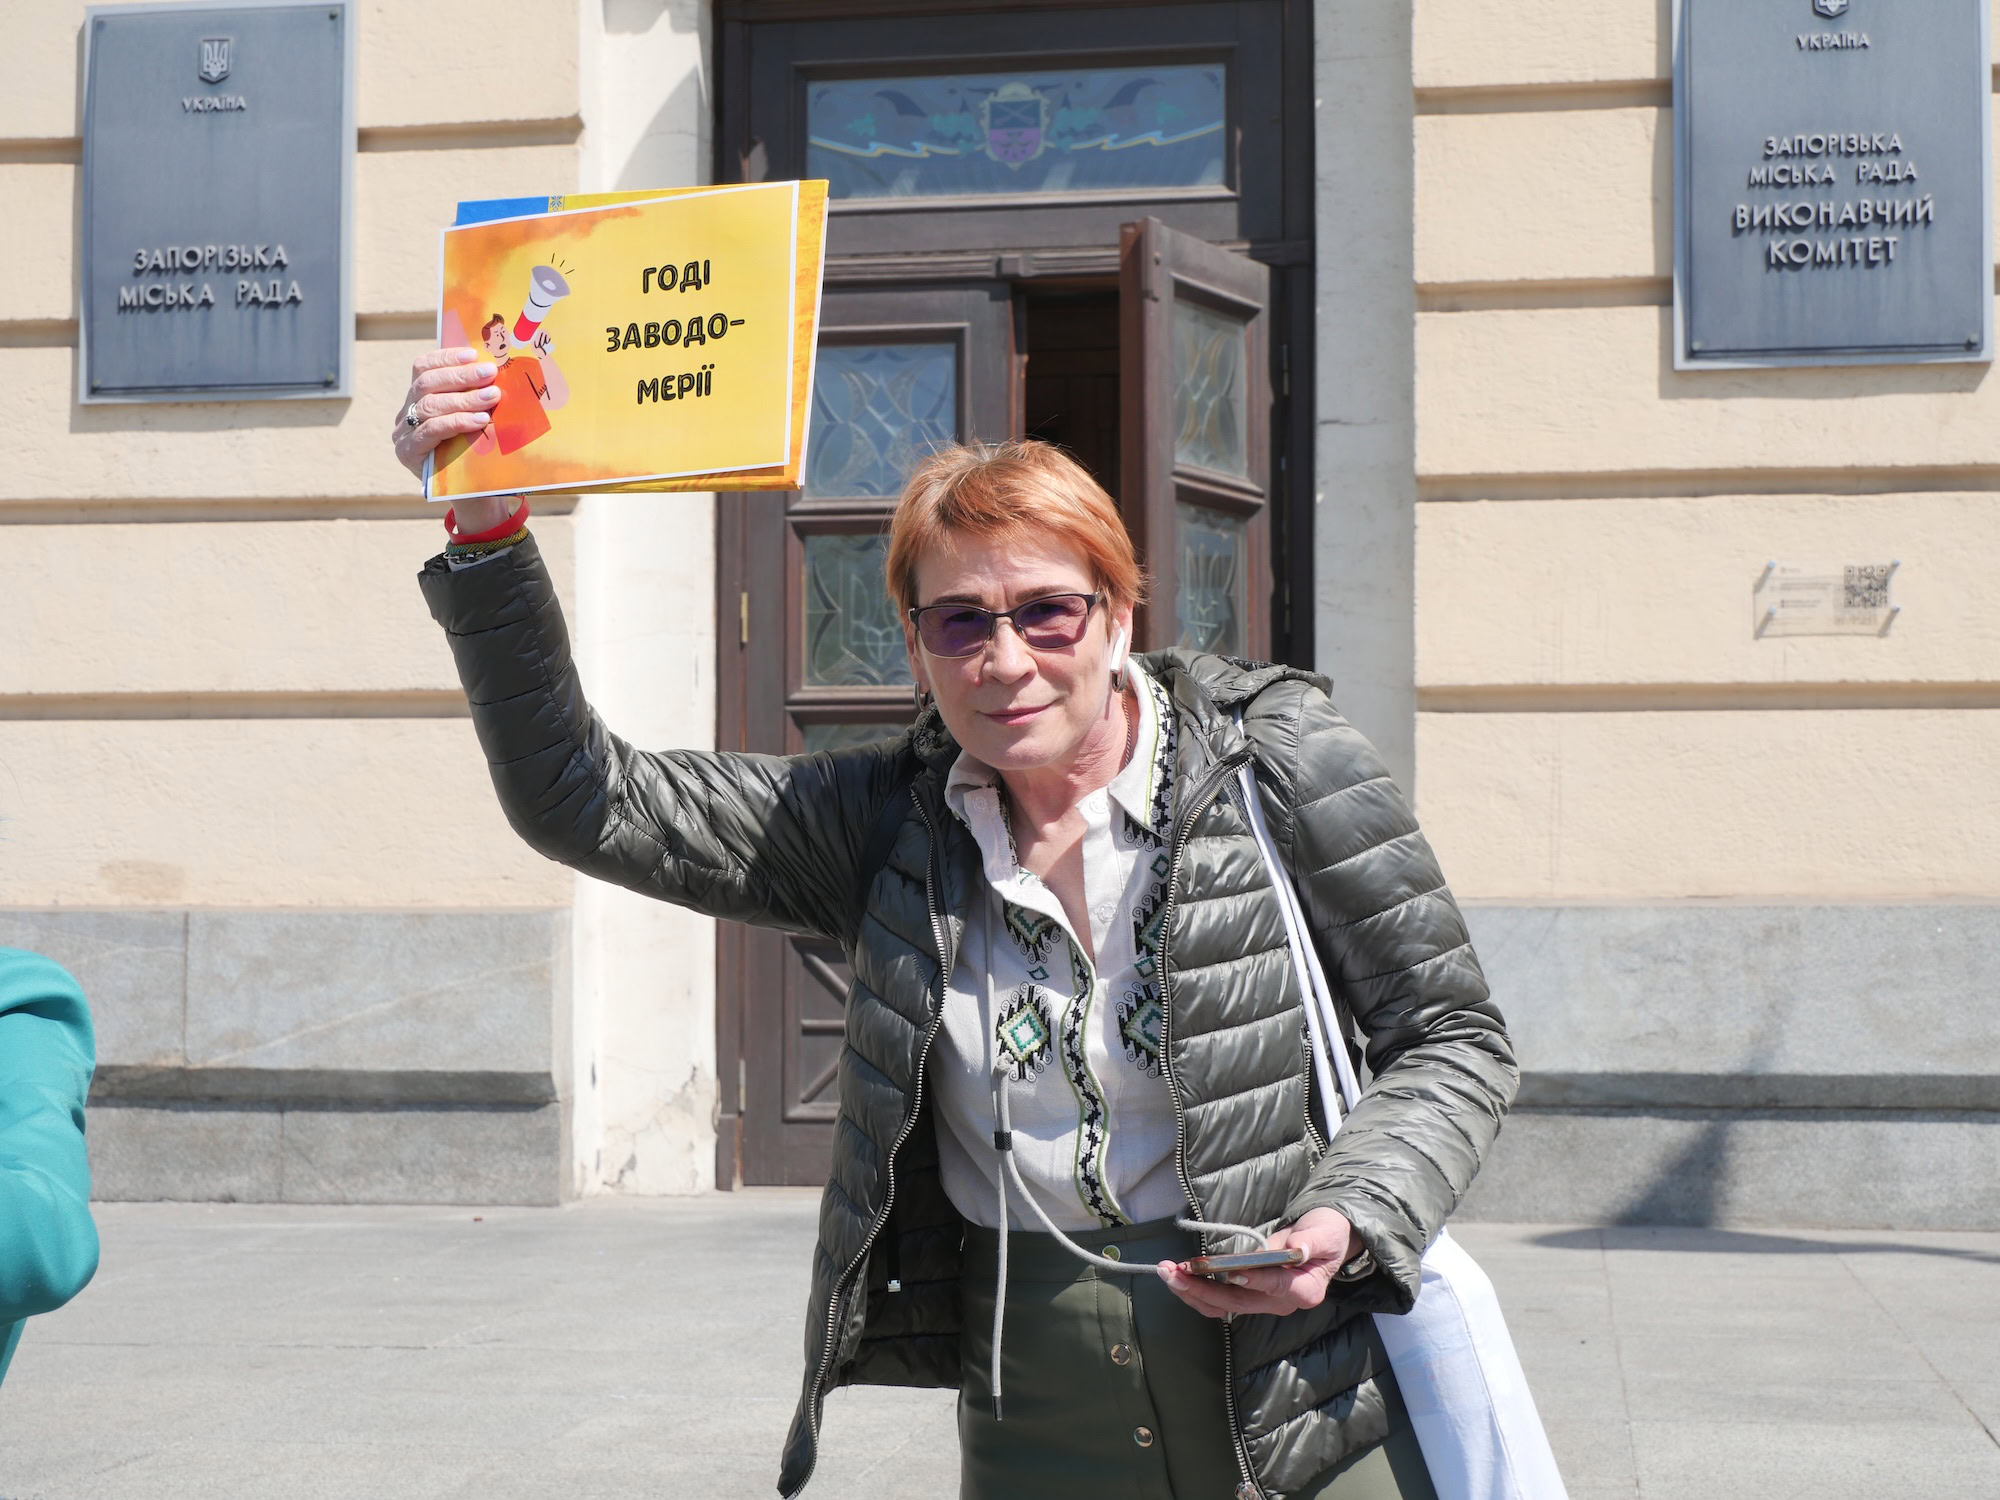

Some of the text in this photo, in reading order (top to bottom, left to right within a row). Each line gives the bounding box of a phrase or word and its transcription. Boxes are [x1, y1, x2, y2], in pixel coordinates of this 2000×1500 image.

[1796, 31, 1871, 50] УКРАЇНА
[1764, 133, 1903, 156] ЗАПОРІЗЬКА
[1750, 160, 1918, 186] МІСЬКА РАДА
[1735, 194, 1935, 229] ВИКОНАВЧИЙ
[134, 244, 289, 271] ЗАПОРІЗЬКА
[1769, 236, 1899, 265] КОМІТЕТ
[642, 259, 711, 294] ГОДІ
[119, 280, 303, 308] МІСЬКА РАДА
[605, 312, 746, 353] ЗАВОДО-
[637, 363, 715, 405] МЕРІЇ
